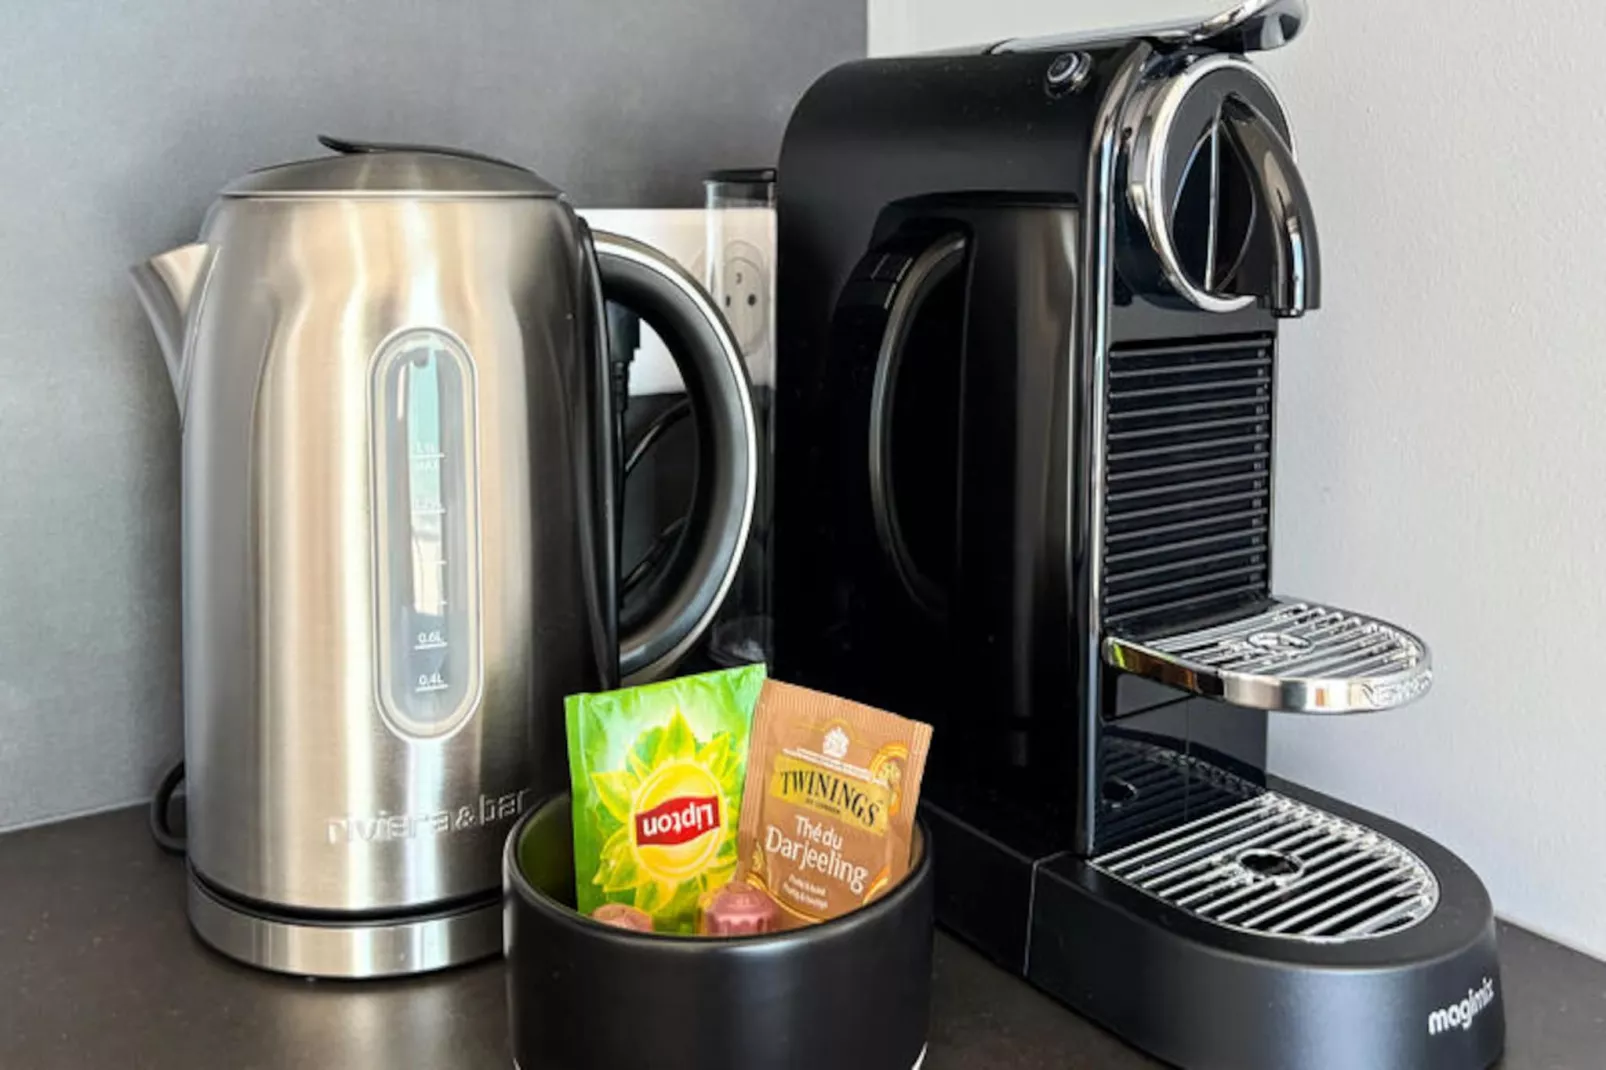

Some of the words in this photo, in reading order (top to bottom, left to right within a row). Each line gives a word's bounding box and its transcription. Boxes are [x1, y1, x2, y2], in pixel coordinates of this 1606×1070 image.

[643, 801, 714, 837] Lipton
[780, 770, 880, 827] TWININGS
[795, 813, 823, 843] Thé
[822, 827, 843, 850] du
[765, 824, 869, 896] Darjeeling
